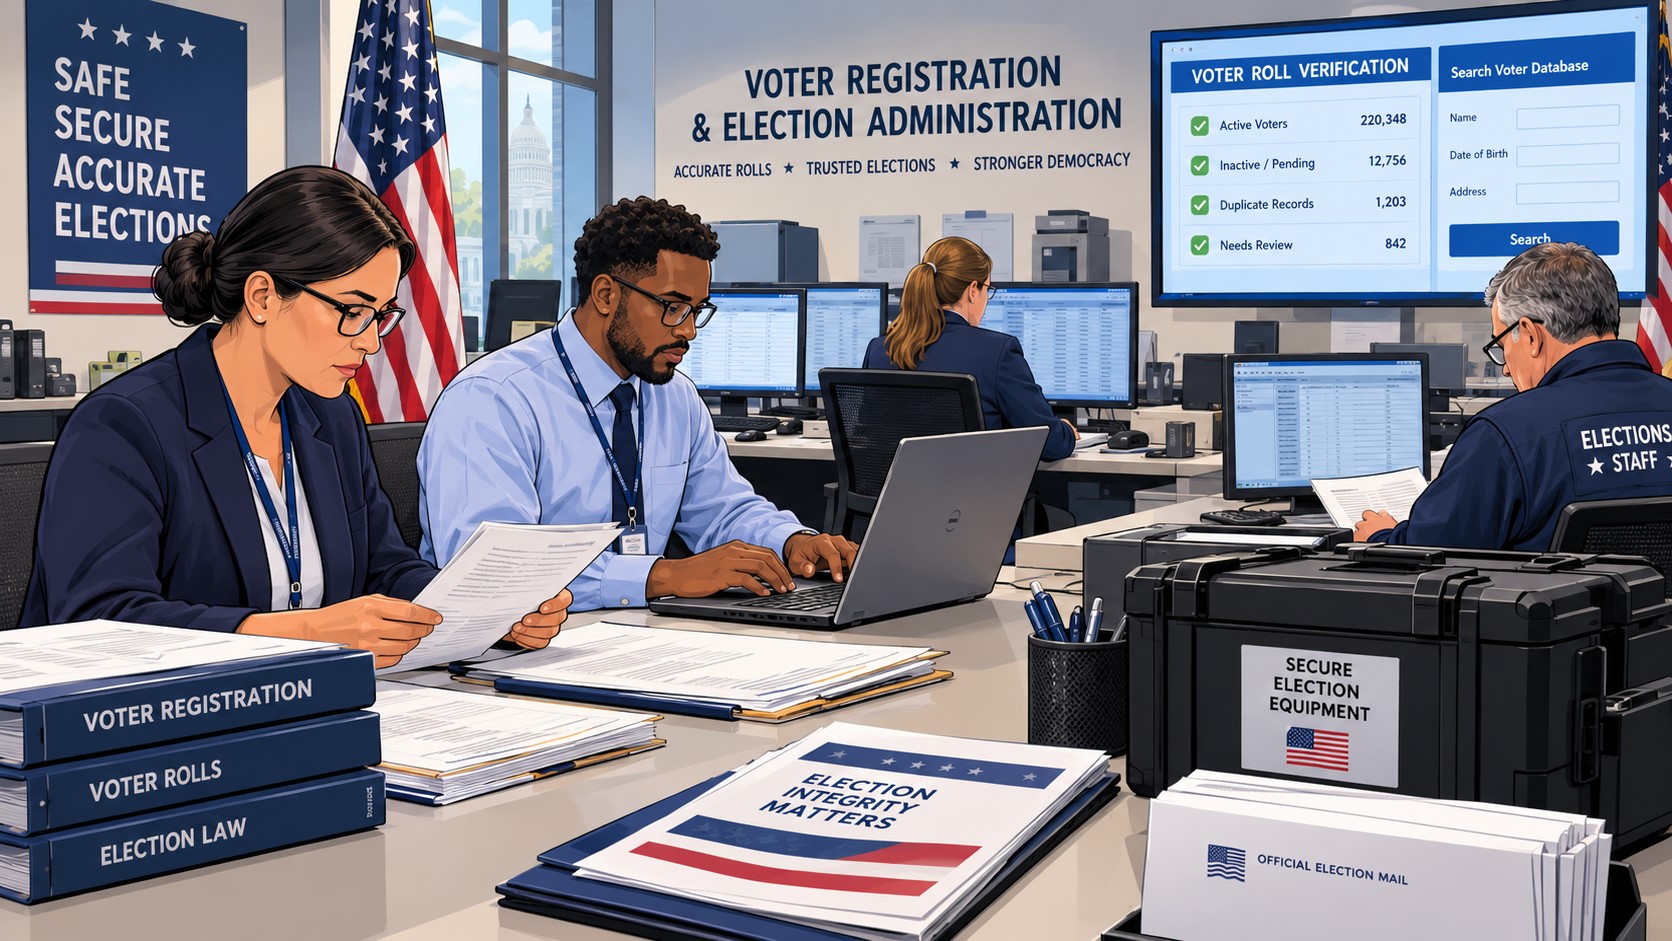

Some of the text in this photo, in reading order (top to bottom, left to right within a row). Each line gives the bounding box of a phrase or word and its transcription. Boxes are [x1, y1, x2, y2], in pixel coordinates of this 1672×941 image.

[54, 57, 130, 101] SAFE
[745, 55, 1061, 99] VOTER REGISTRATION
[1191, 57, 1409, 84] VOTER ROLL VERIFICATION
[1451, 59, 1589, 79] Search Voter Database
[55, 104, 170, 152] SECURE
[692, 97, 1121, 143] & ELECTION ADMINISTRATION
[1219, 119, 1288, 131] Active Voters
[1361, 113, 1407, 127] 220,348
[1450, 113, 1477, 122] Name
[674, 152, 1131, 178] ACCURATE ROLLS TRUSTED ELECTIONS STRONGER DEMOCRACY
[1220, 157, 1315, 171] Inactive / Pending
[1369, 154, 1407, 168] 12,756
[1450, 148, 1508, 160] Date of Birth
[53, 153, 206, 202] ACCURATE
[1376, 196, 1406, 209] 1,203
[1449, 186, 1487, 197] Address
[1220, 198, 1314, 213] Duplicate Records
[1220, 239, 1293, 251] Needs Review
[1385, 238, 1406, 249] 842
[1510, 232, 1551, 246] Search
[1580, 424, 1672, 450] ELECTIONS
[1612, 450, 1658, 472] STAFF
[1286, 657, 1352, 677] SECURE
[1274, 676, 1359, 699] ELECTION
[83, 678, 312, 732] VOTER REGISTRATION
[1270, 696, 1371, 721] EQUIPMENT
[89, 759, 222, 802] VOTER ROLLS
[801, 773, 937, 801] ELECTION
[782, 786, 920, 815] INTEGRITY
[759, 799, 897, 829] MATTERS
[101, 817, 247, 866] ELECTION LAW
[1257, 854, 1408, 886] OFFICIAL ELECTION MAIL
